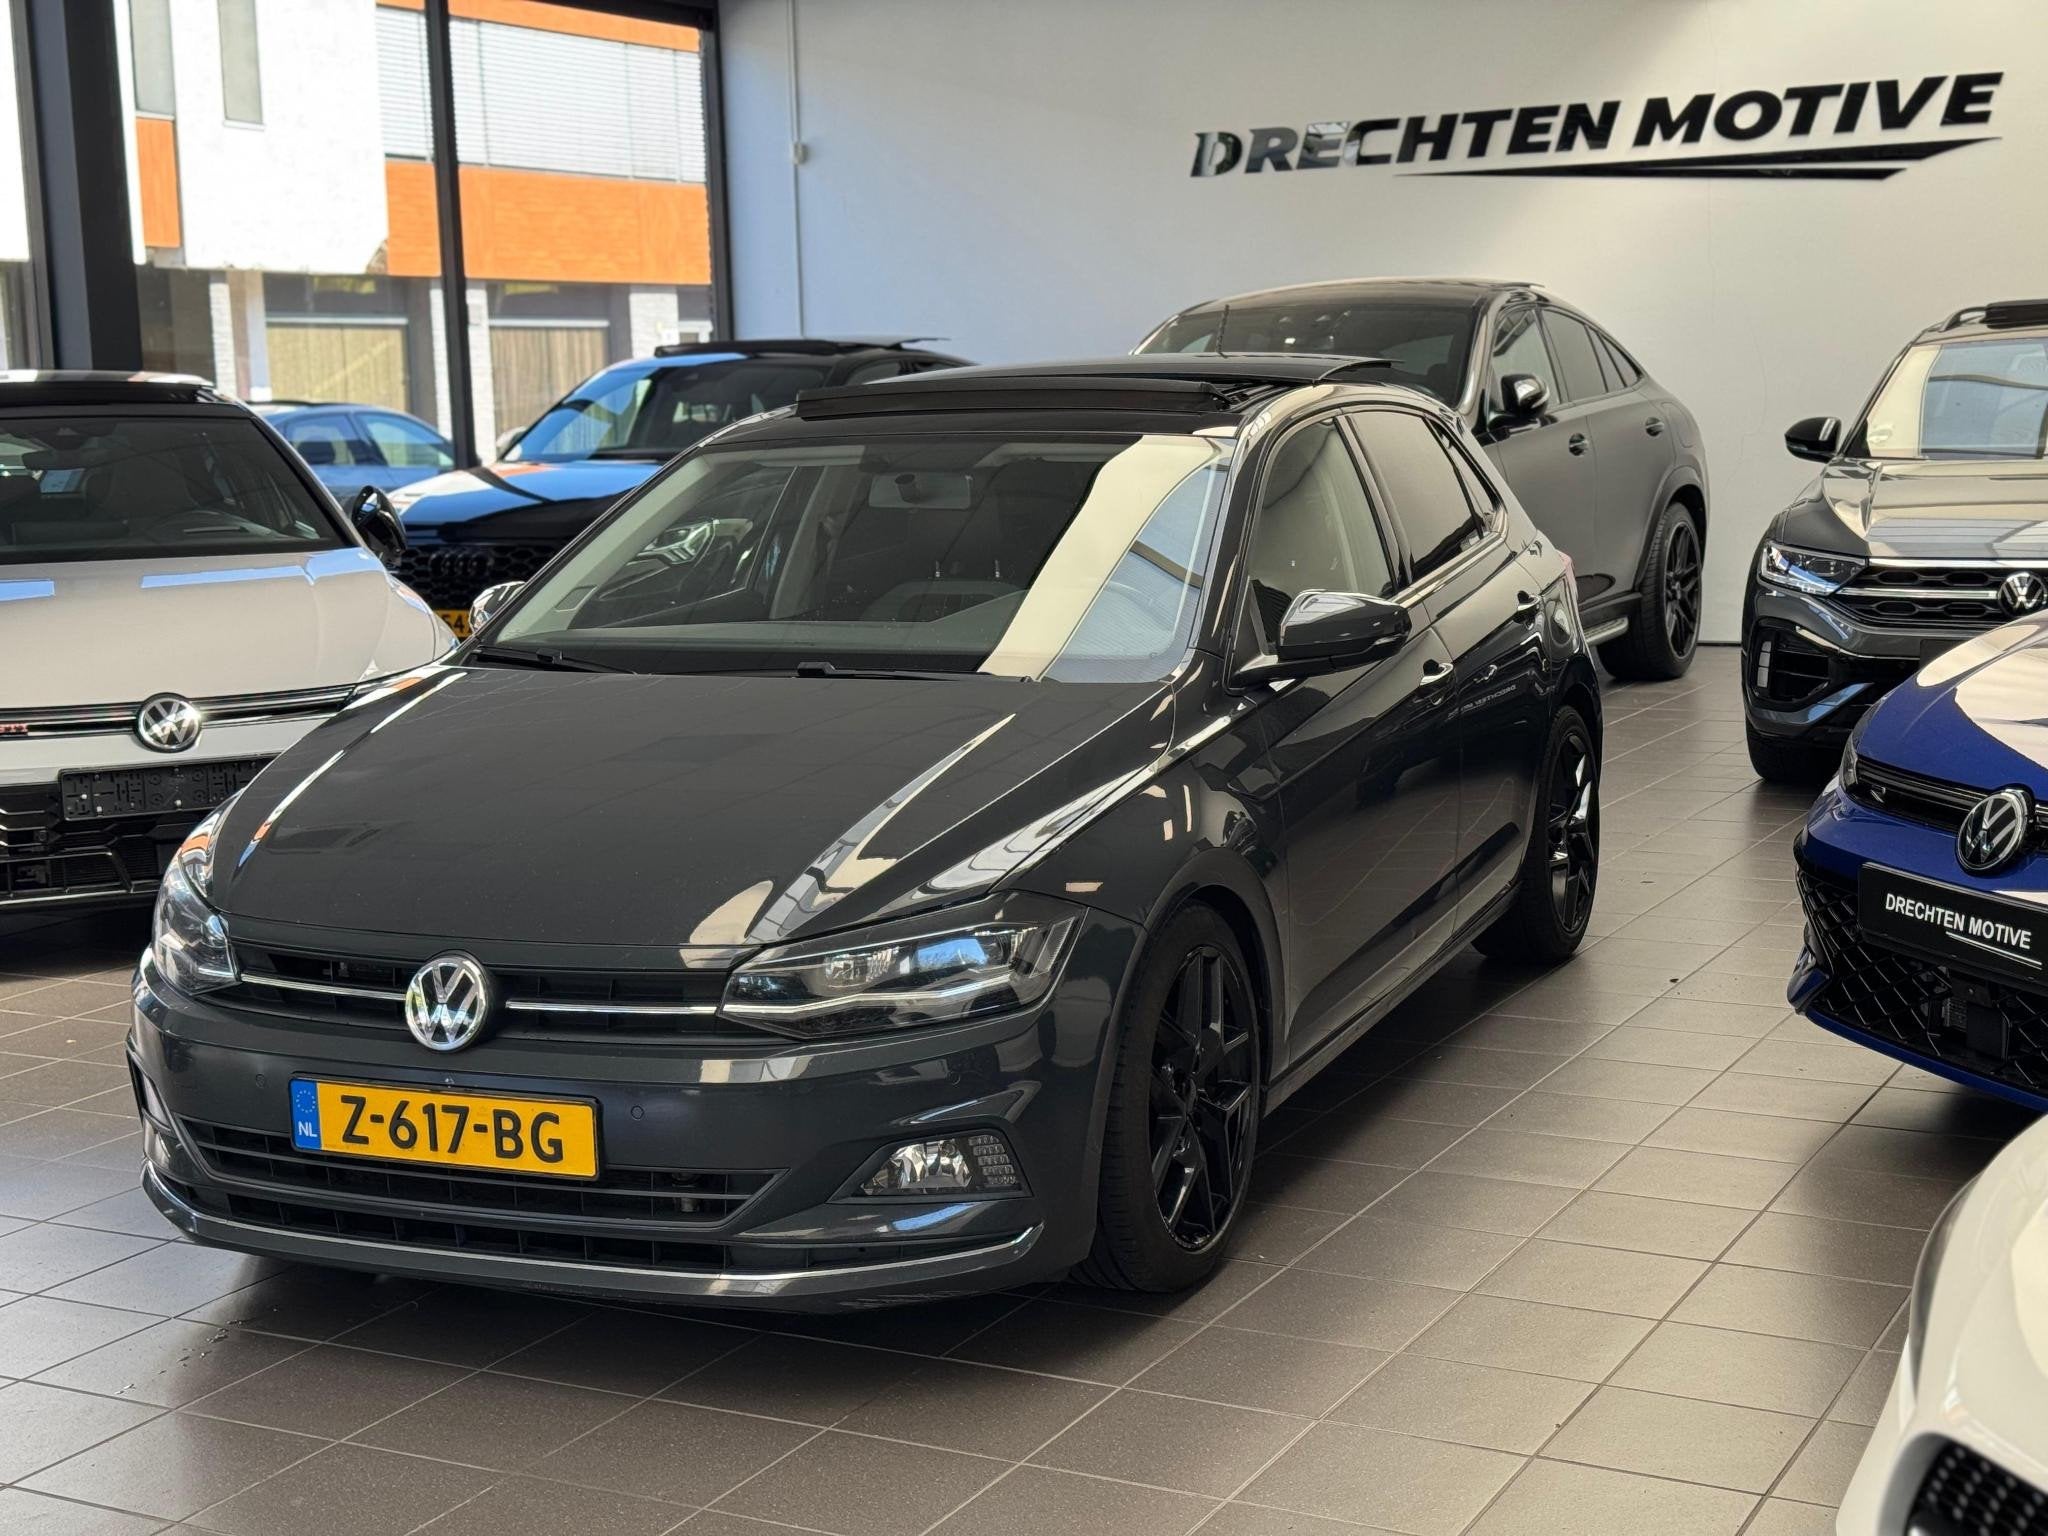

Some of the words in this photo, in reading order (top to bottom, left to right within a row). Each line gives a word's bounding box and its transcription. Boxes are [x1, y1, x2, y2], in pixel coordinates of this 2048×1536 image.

[1190, 100, 1621, 177] DRECHTEN
[1632, 72, 2003, 147] MOTIVE
[1885, 892, 1966, 932] DRECHTEN
[1968, 916, 2032, 950] MOTIVE
[298, 1121, 318, 1138] NL
[340, 1094, 564, 1164] Z-617-BG
